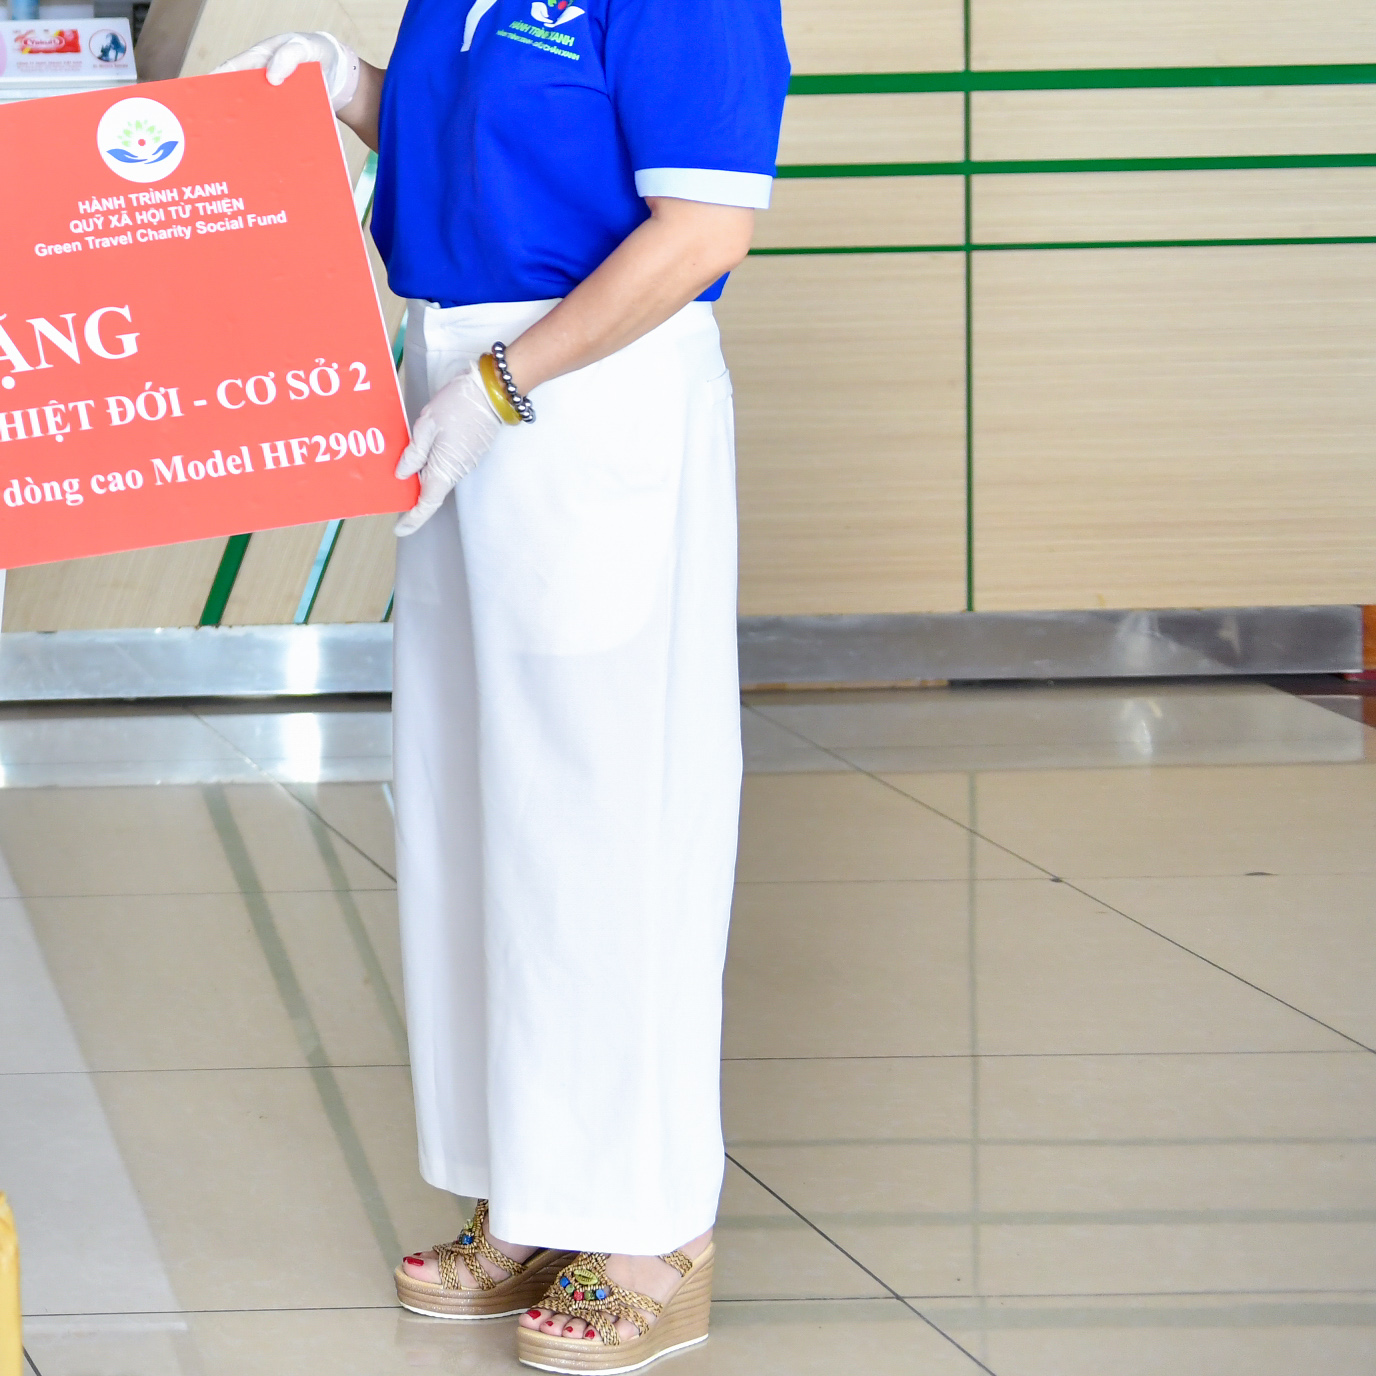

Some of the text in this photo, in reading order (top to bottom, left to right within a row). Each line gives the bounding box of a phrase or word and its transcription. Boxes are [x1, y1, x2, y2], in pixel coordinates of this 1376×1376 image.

[69, 197, 245, 234] QUỸ XÃ HỘI TỪ THIỆN
[78, 181, 229, 214] HÀNH TRÌNH XANH
[34, 210, 288, 257] Green Travel Charity Social Fund
[105, 381, 185, 427] ĐỚI
[193, 399, 208, 407] -
[216, 371, 277, 410] CƠ
[285, 357, 341, 401] SỞ
[348, 361, 372, 392] 2
[3, 477, 84, 507] dòng
[90, 468, 144, 494] cao
[149, 445, 255, 486] Model
[258, 427, 386, 471] HF2900
